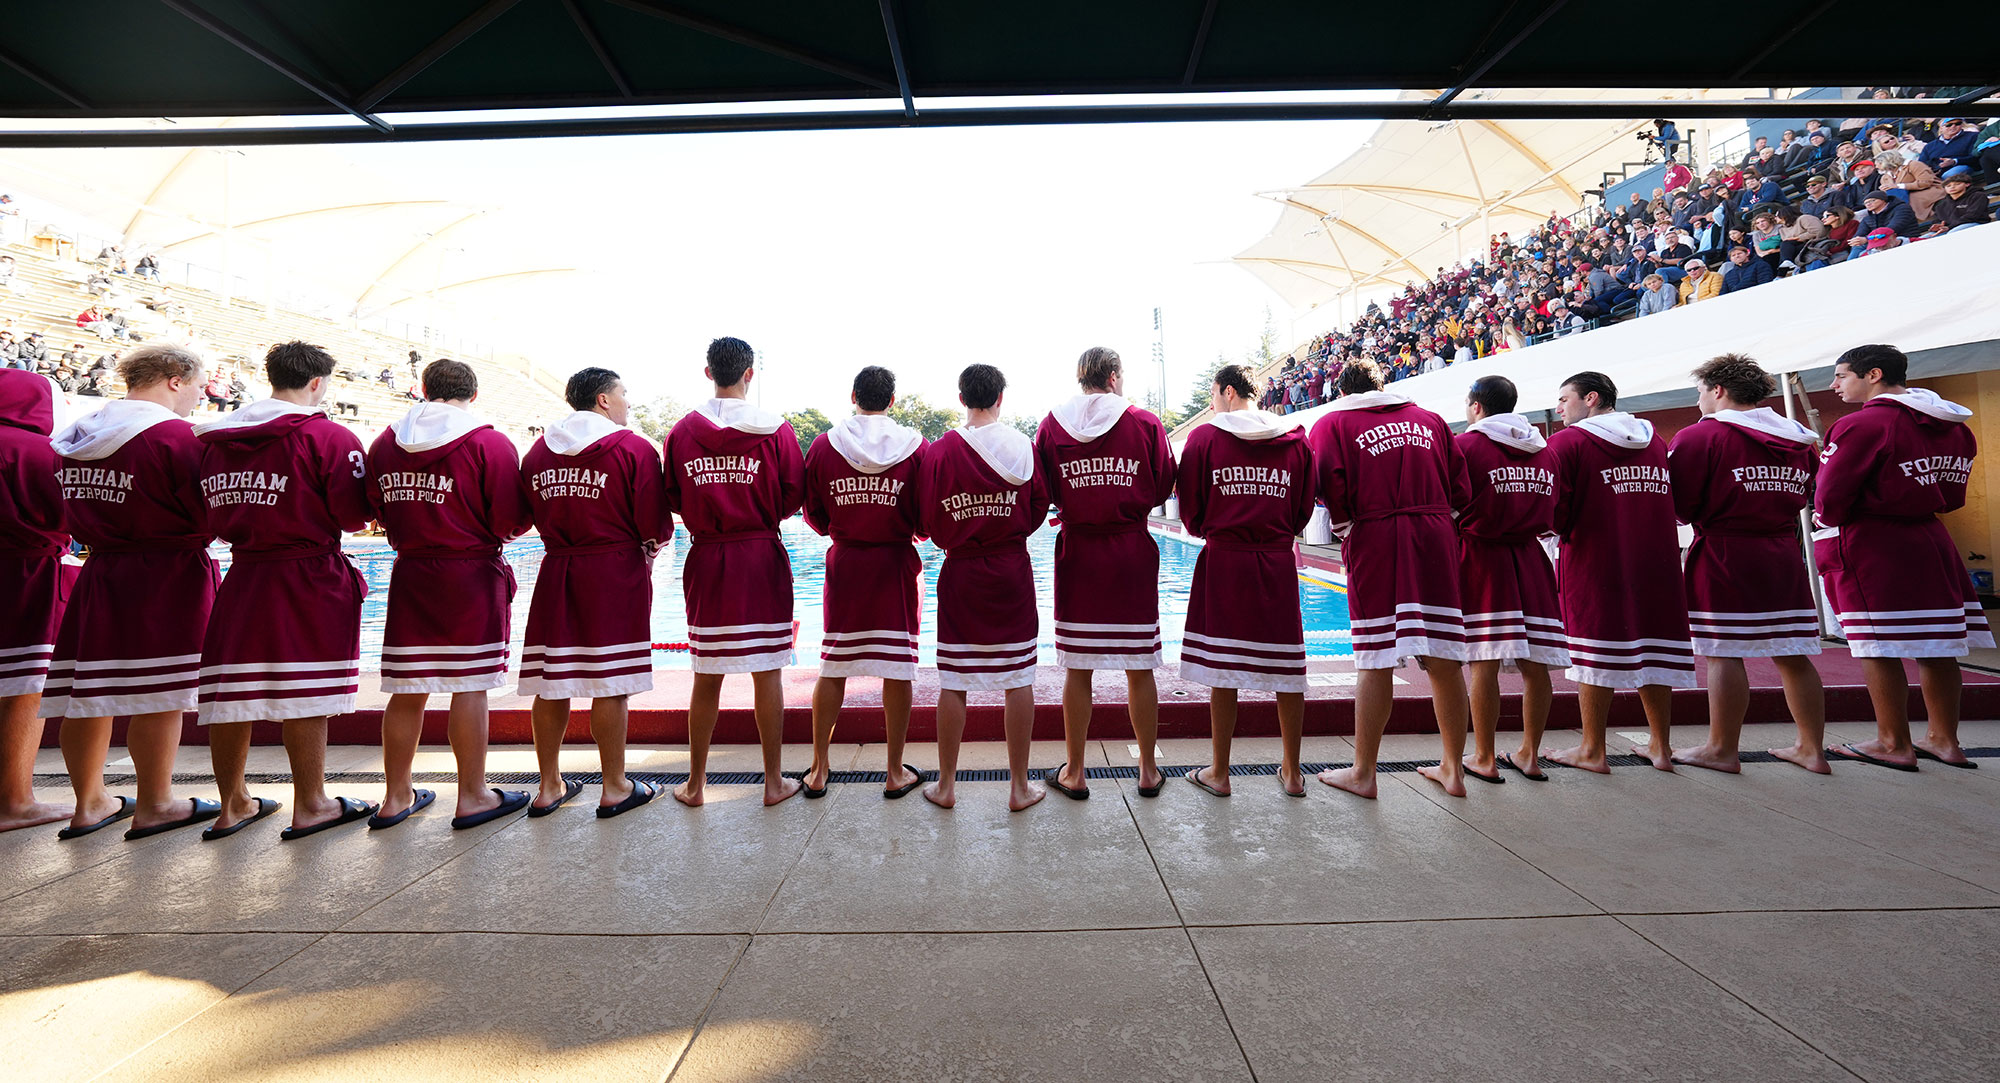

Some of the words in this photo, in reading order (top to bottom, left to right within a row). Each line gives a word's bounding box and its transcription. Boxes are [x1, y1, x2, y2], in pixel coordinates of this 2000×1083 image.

[1355, 421, 1434, 450] FORDHAM
[1367, 436, 1406, 457] WATER
[1406, 434, 1431, 450] POLO
[348, 450, 366, 479] 3
[684, 455, 761, 477] FORDHAM
[1059, 456, 1141, 478] FORDHAM
[1898, 456, 1975, 477] FODHAM
[54, 468, 134, 490] FRDHAM
[200, 471, 289, 497] FORDHAM
[378, 471, 454, 493] FORDHAM
[531, 468, 608, 491] FORDHAM
[693, 472, 727, 487] WATER
[729, 472, 754, 485] POLO
[1068, 474, 1104, 489] WATER
[1106, 474, 1133, 487] POLO
[1212, 466, 1291, 487] FORDHAM
[1488, 466, 1555, 486] FORDHAM
[1600, 465, 1671, 484] FORDHAM
[1731, 465, 1811, 484] FORDHAM
[1914, 472, 1938, 487] WAR
[1938, 472, 1967, 484] POLO
[62, 487, 94, 500] TER
[94, 488, 126, 504] POLO
[569, 485, 600, 500] POLO
[829, 476, 905, 496] FORDHAM
[1219, 483, 1257, 496] WATER
[1259, 484, 1287, 499] POLO
[1494, 482, 1526, 494] WATER
[1528, 482, 1552, 496] POLO
[1611, 481, 1642, 495] WATER
[1643, 482, 1668, 495] POLO
[1743, 481, 1782, 492] WATER
[1783, 482, 1806, 496] POLO
[208, 491, 241, 509] WATER
[243, 491, 278, 506] POLO
[417, 490, 445, 504] POLO
[834, 493, 869, 507] WATER
[870, 493, 897, 507] POLO
[941, 490, 1018, 512] FORDHAM
[951, 505, 985, 522] WATER
[986, 505, 1012, 517] POLO
